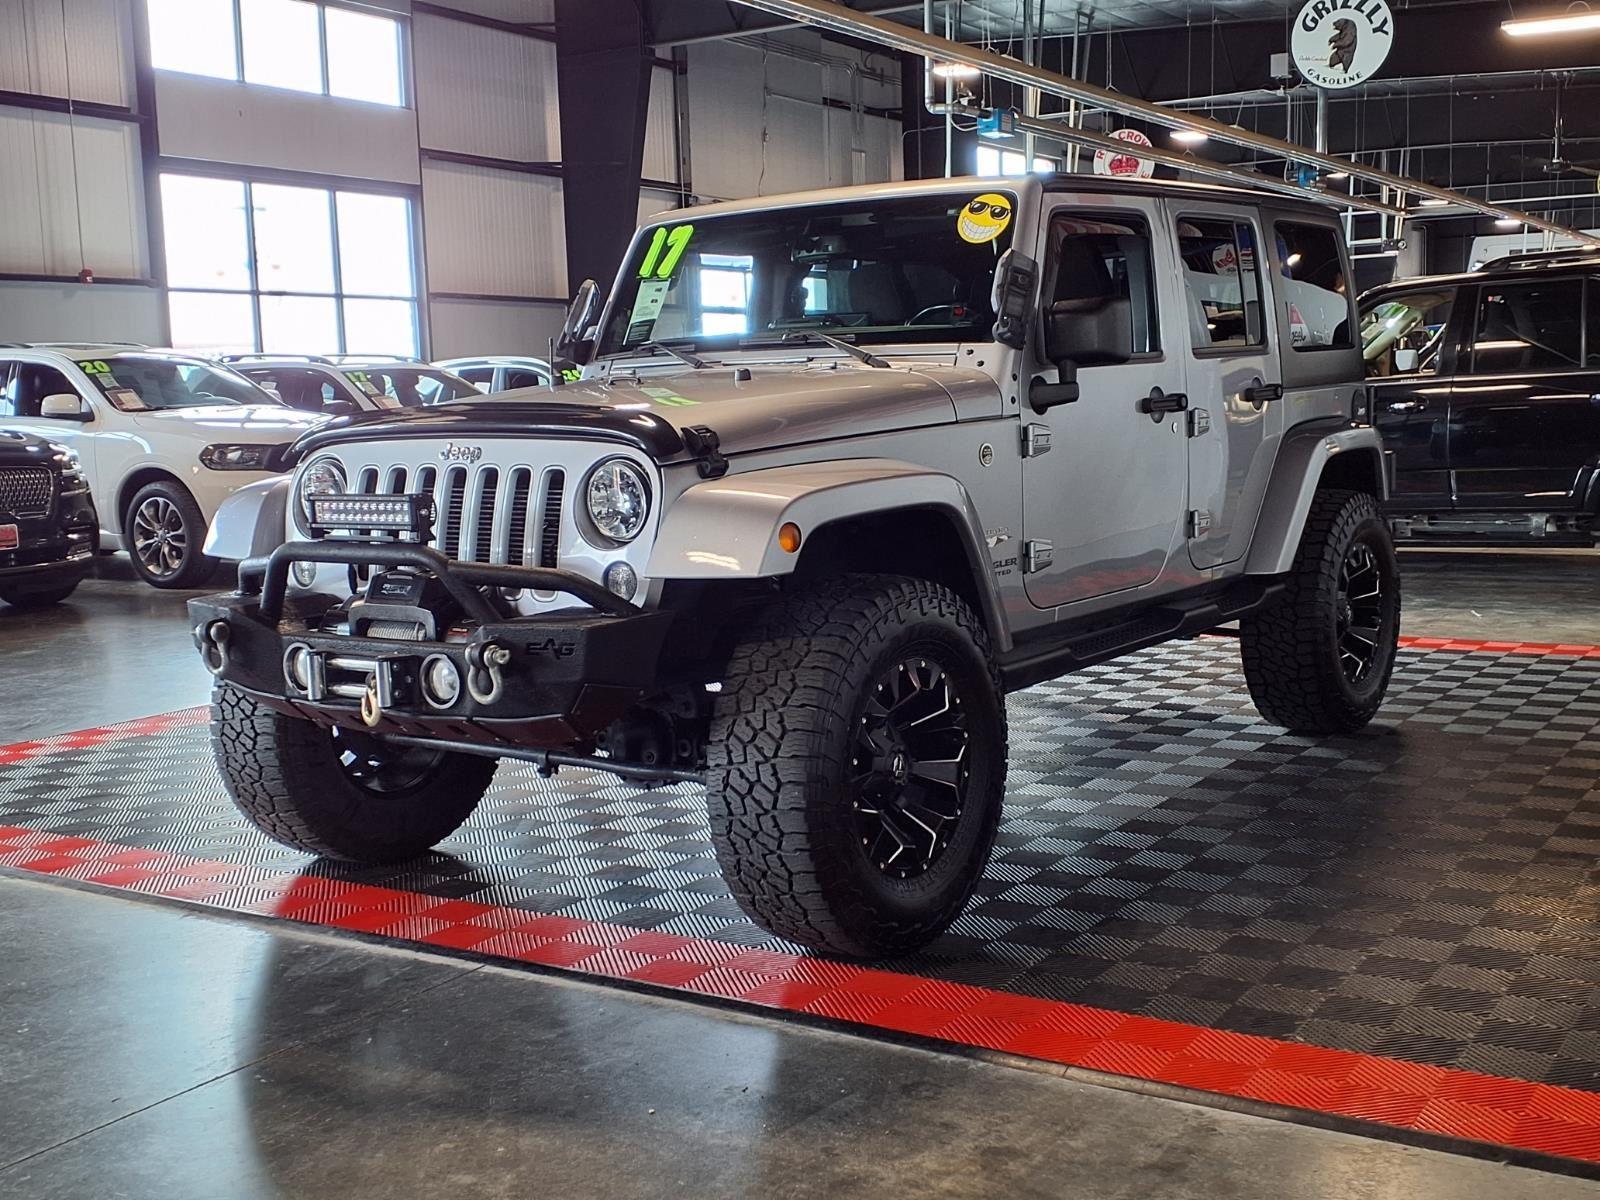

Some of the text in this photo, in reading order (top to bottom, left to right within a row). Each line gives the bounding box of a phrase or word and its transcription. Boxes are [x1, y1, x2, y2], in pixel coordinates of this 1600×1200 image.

[1307, 68, 1364, 85] GASOLINE
[639, 225, 694, 278] 17
[79, 360, 112, 374] 20
[439, 441, 482, 464] Jeep
